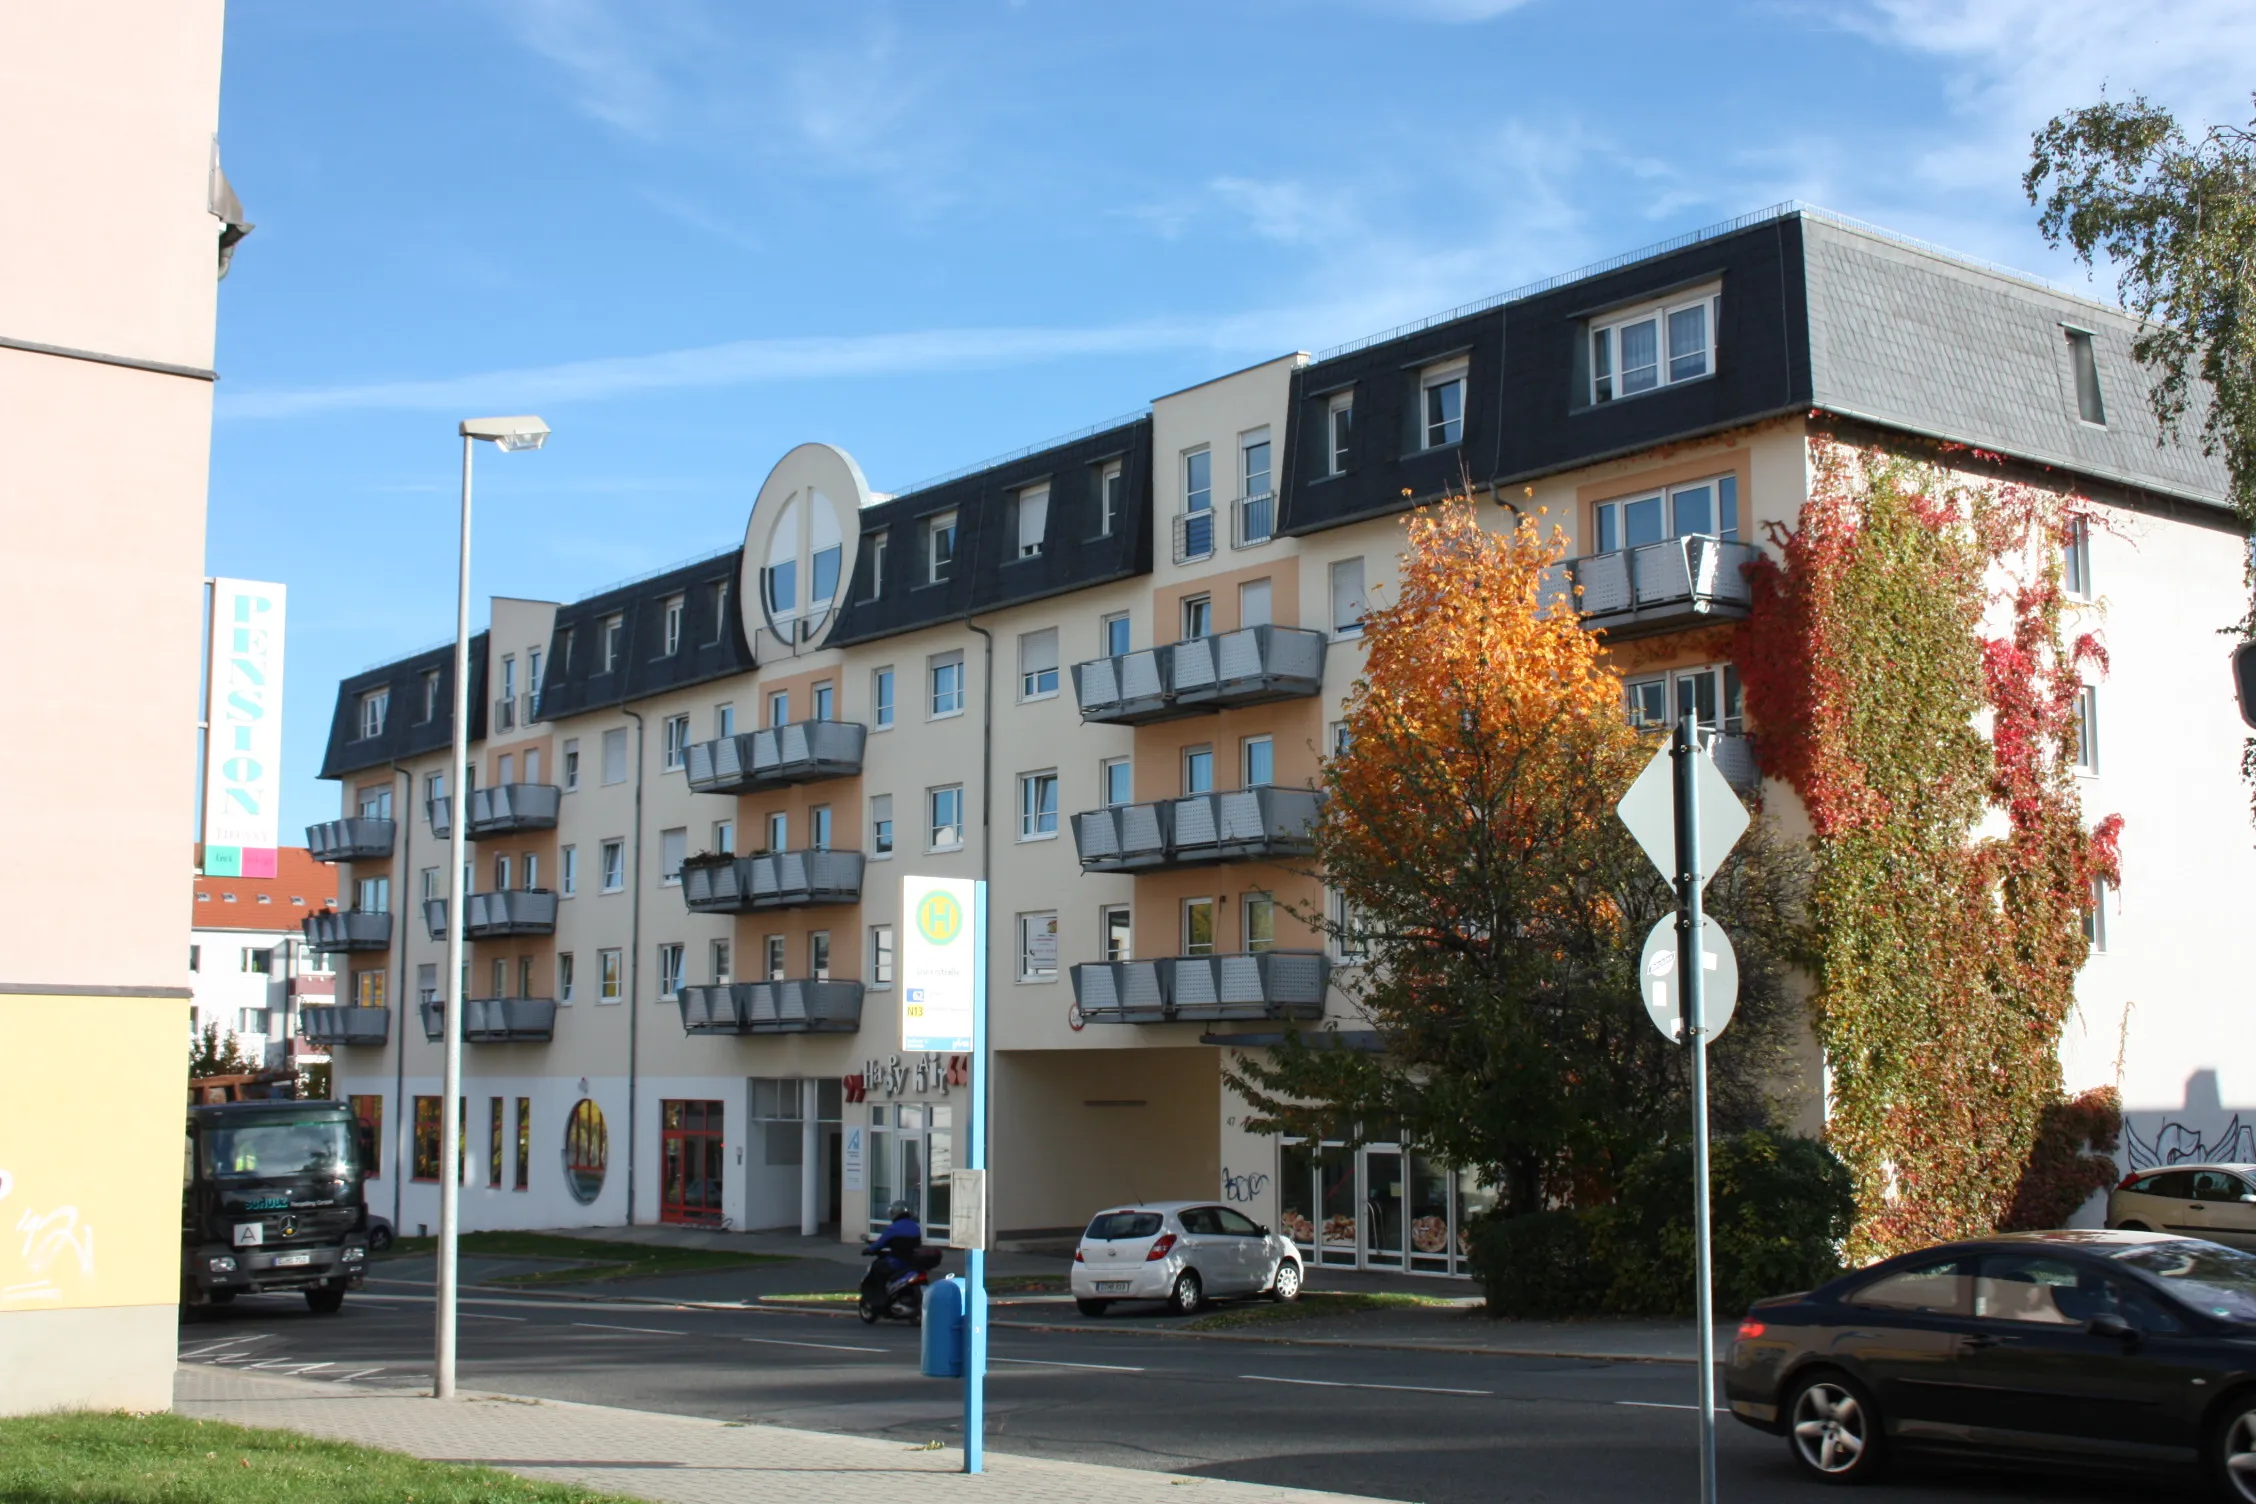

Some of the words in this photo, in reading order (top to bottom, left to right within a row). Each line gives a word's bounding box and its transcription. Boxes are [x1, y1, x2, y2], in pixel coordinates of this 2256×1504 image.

[222, 594, 273, 816] PENSION
[929, 902, 950, 933] H
[907, 1006, 924, 1017] N13
[1226, 1116, 1236, 1126] 47
[240, 1226, 256, 1243] A
